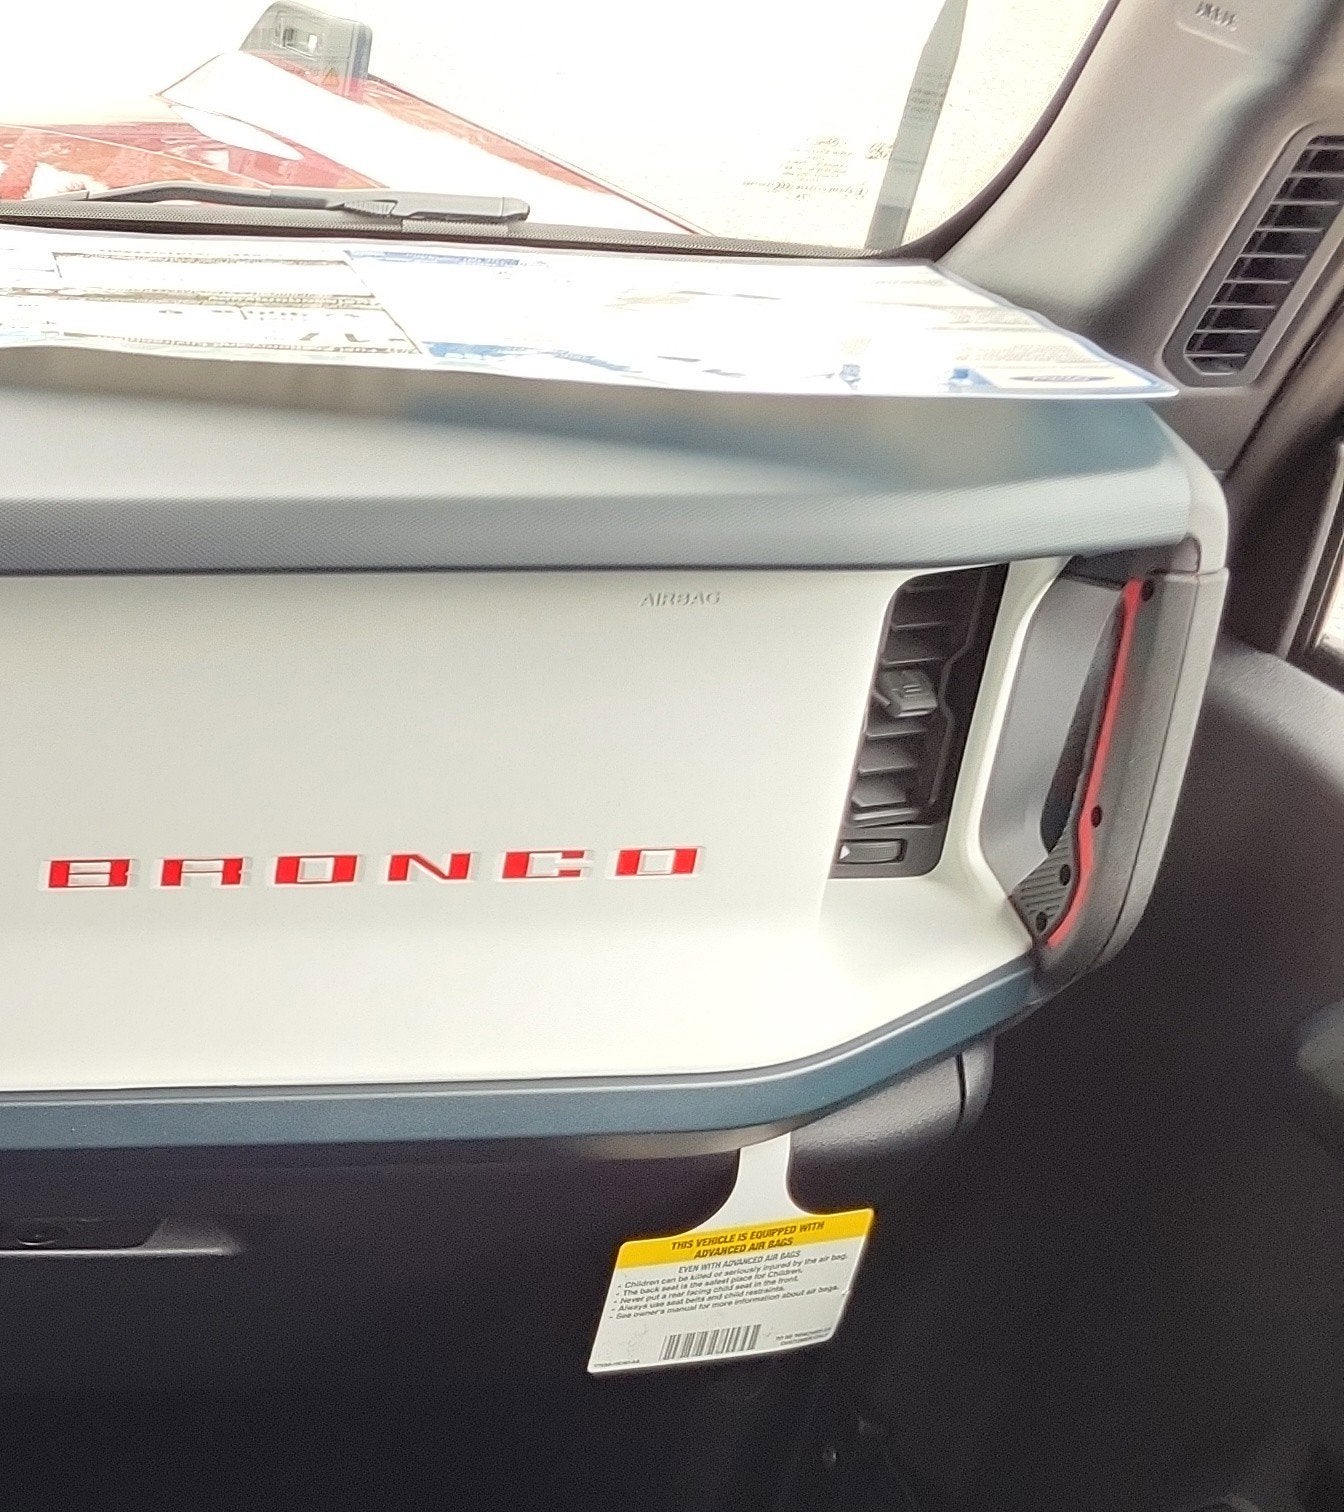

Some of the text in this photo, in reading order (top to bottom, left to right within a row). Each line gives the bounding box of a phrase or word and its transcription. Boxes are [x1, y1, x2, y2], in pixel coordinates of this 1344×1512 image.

[47, 848, 698, 888] BRONCO
[672, 1221, 825, 1250] THIS VEHICLE IS EQUIPPED WITH
[694, 1237, 794, 1259] ADVANCED AIR BAGS
[678, 1250, 801, 1274] EVEN WITH ADVANCED AIR BAGS
[624, 1280, 660, 1289] Children
